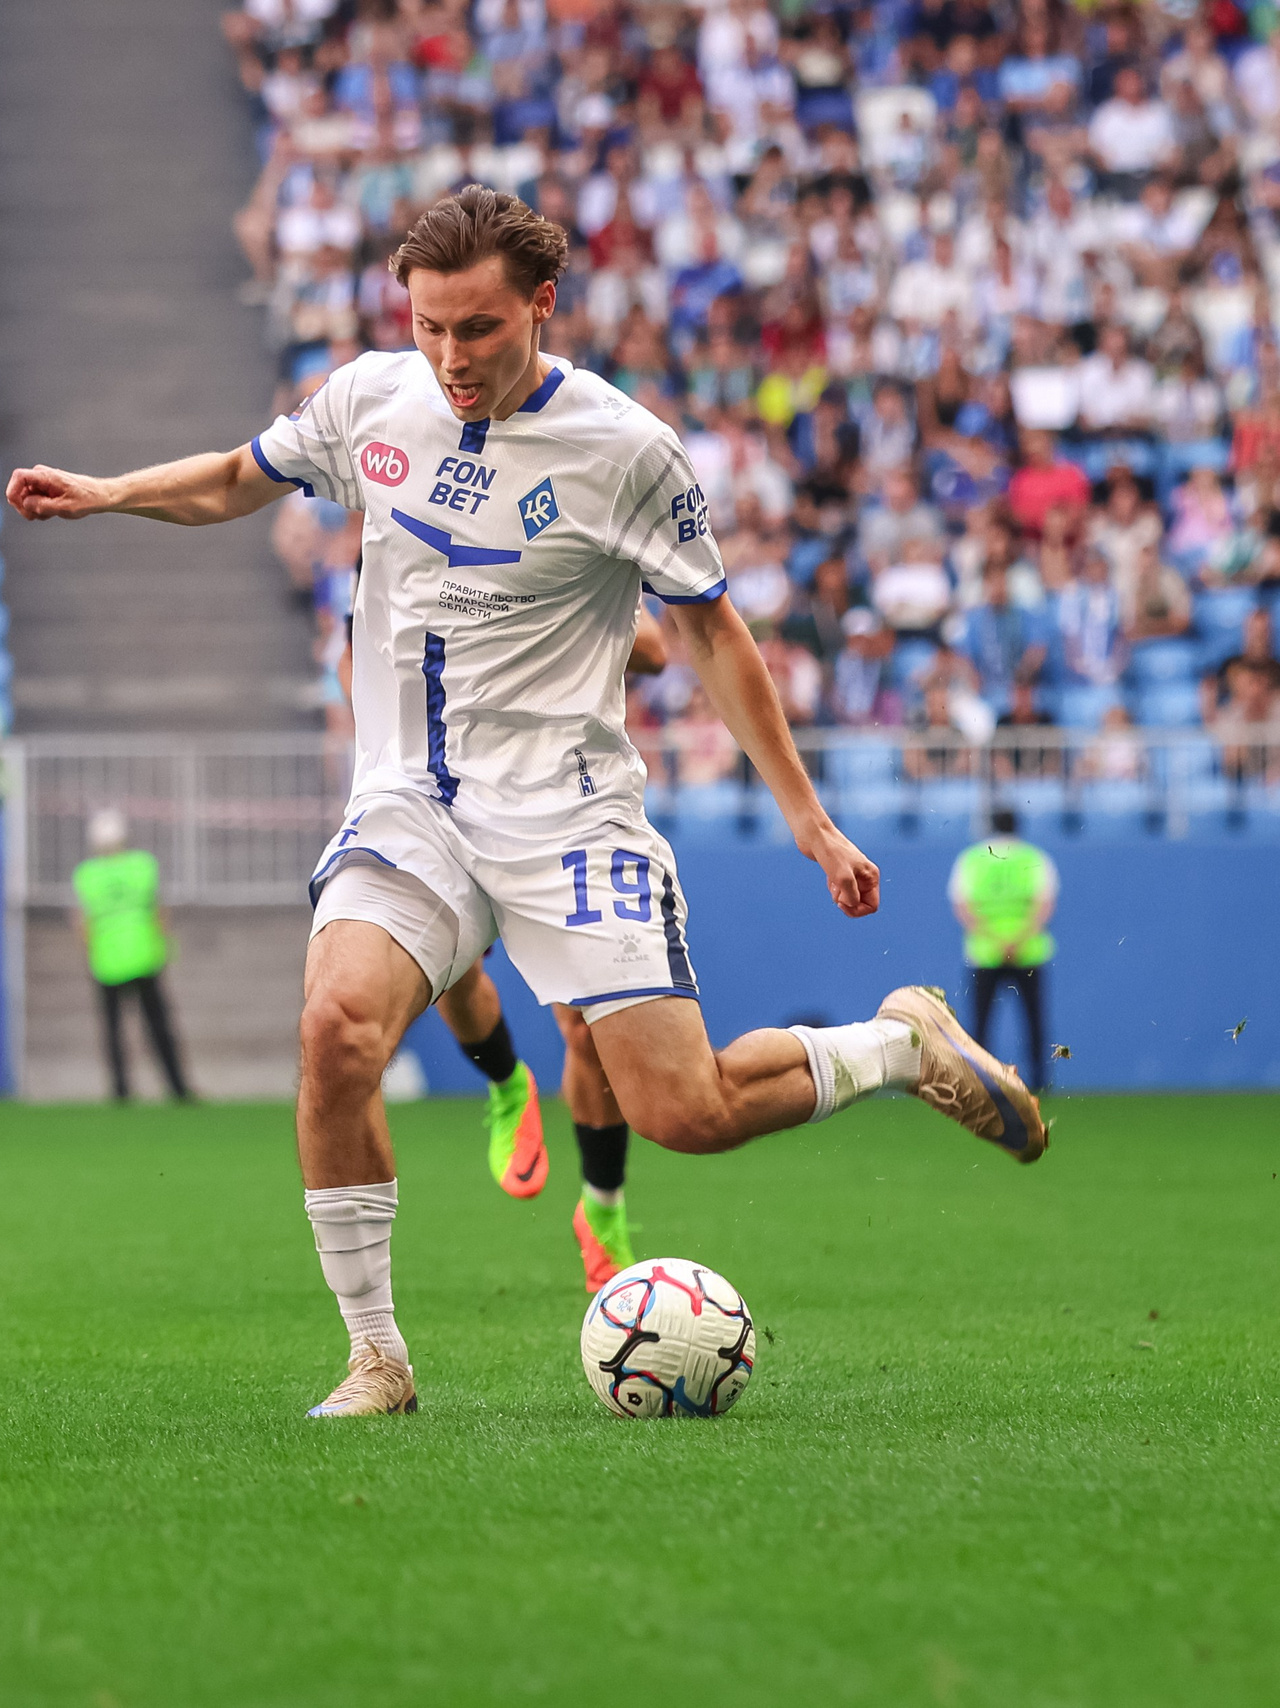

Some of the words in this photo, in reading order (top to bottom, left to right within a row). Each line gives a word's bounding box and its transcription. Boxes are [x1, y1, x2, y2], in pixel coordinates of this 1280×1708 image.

[435, 456, 498, 491] FON
[427, 481, 491, 516] BET
[439, 591, 510, 613] САМАРСКОЙ
[442, 580, 537, 604] ПРАВИТЕЛЬСТВО
[438, 601, 492, 619] ОБЛАСТИ
[561, 848, 652, 927] 19
